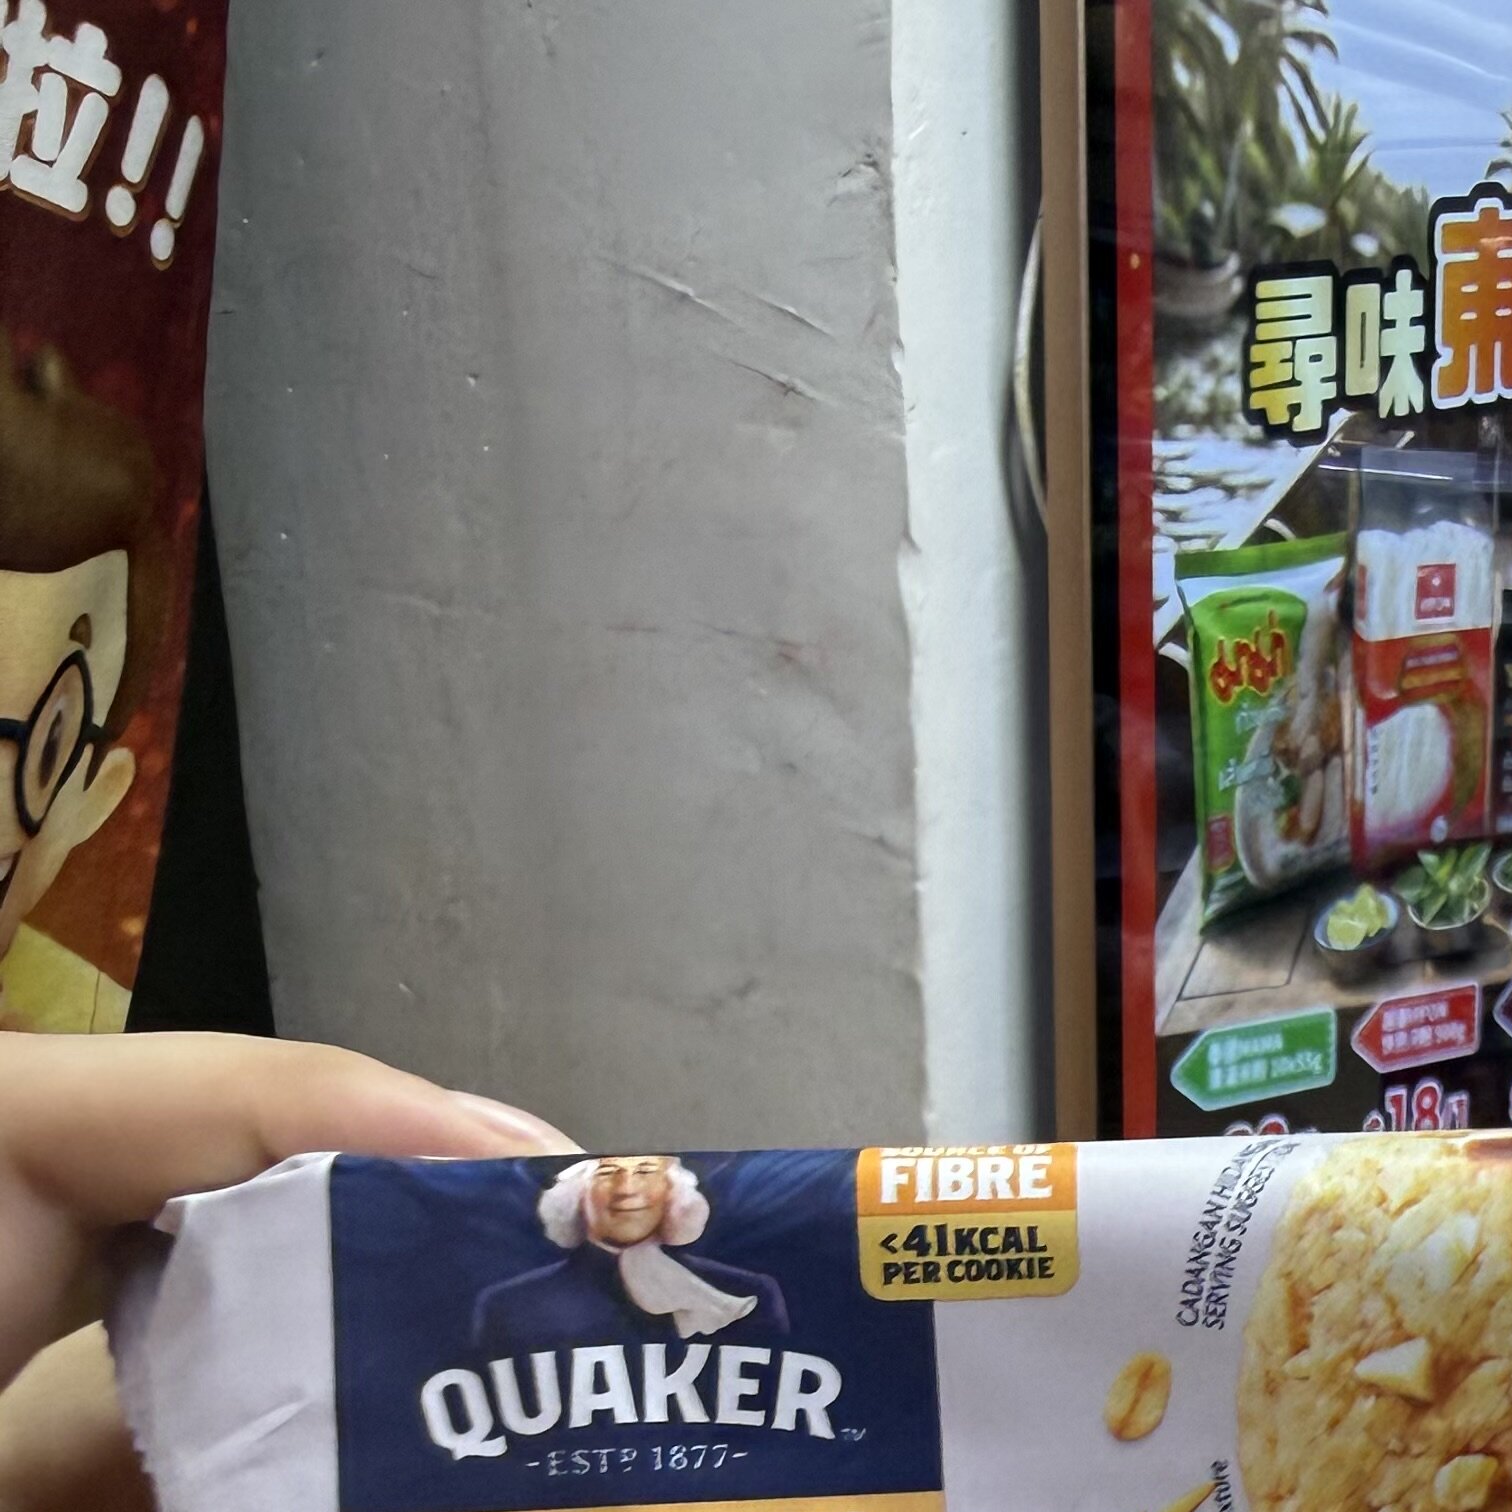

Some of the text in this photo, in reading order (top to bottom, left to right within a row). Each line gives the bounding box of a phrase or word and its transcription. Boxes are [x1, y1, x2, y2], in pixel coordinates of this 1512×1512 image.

[880, 1156, 1053, 1204] FIBRE
[883, 1257, 1055, 1285] PER COOKIE
[1176, 1200, 1227, 1326] CADANGAN
[1202, 1236, 1242, 1330] SERVING
[420, 1343, 843, 1461] QUAKER
